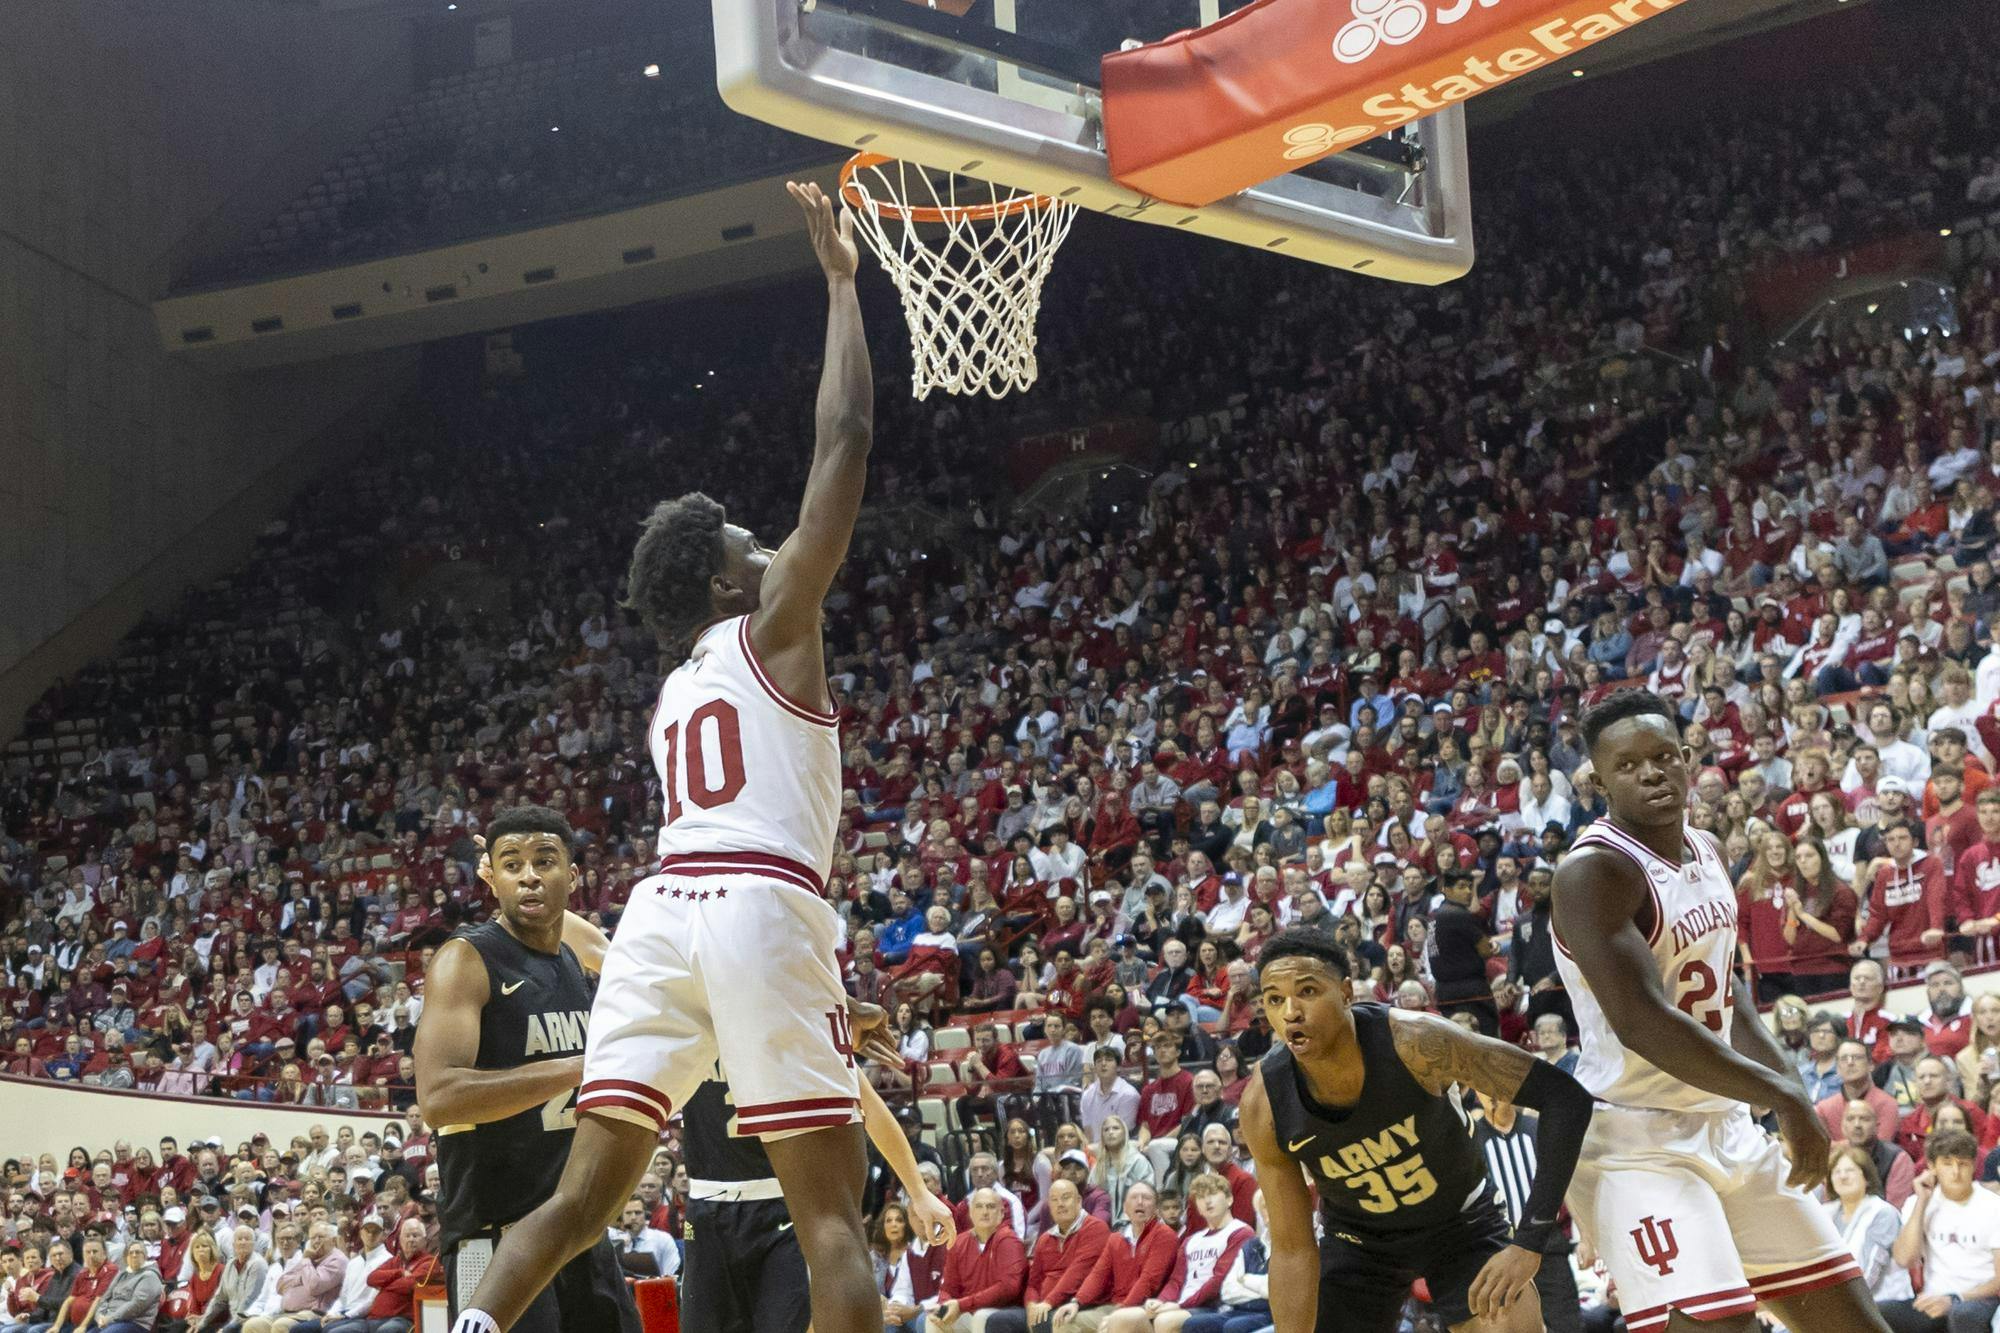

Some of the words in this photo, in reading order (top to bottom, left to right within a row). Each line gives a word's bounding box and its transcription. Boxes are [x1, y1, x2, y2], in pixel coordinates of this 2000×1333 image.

[1362, 47, 1546, 125] State
[1071, 434, 1086, 451] H
[664, 697, 747, 827] 10
[1319, 1114, 1421, 1180] ARMY
[1345, 1153, 1438, 1214] 35
